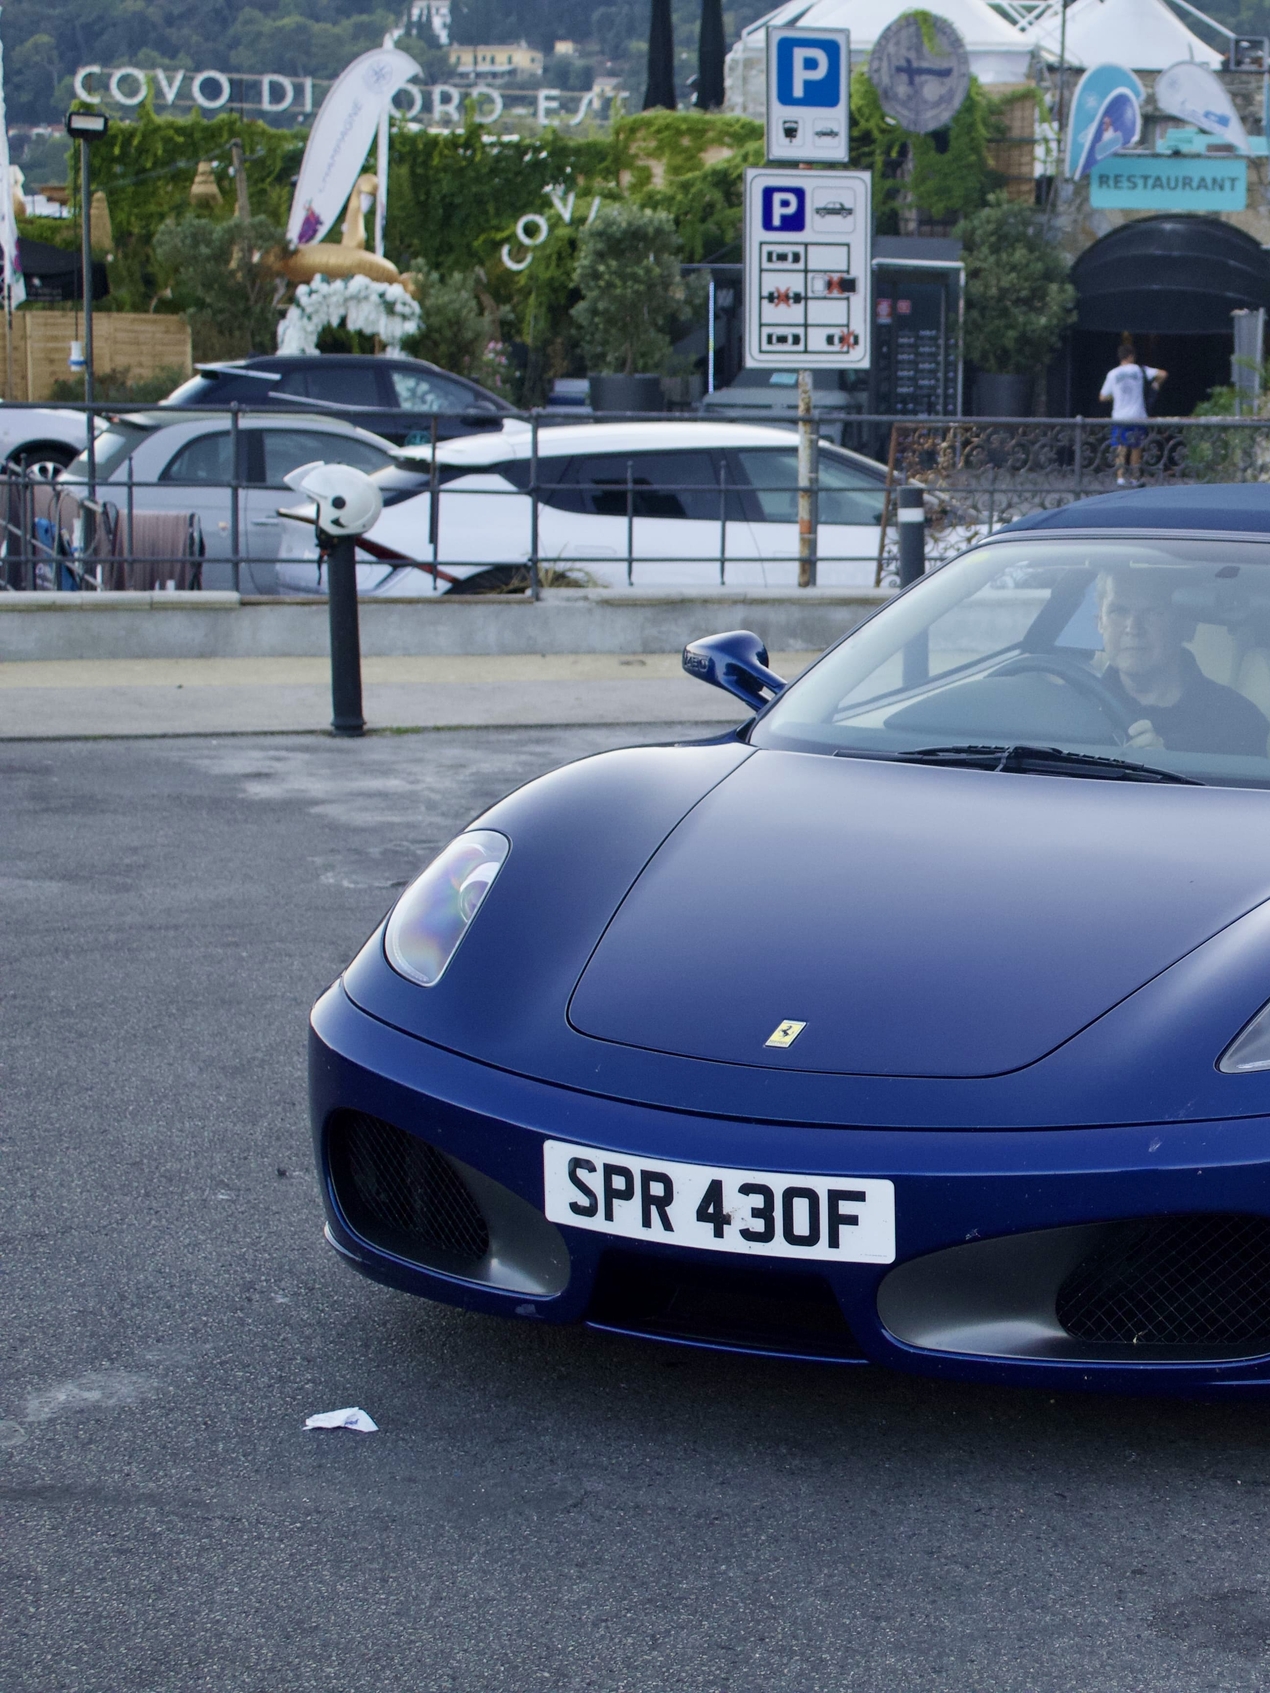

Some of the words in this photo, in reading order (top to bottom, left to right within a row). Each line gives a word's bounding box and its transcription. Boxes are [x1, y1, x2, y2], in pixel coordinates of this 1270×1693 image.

[73, 65, 231, 109] COVO
[261, 73, 313, 114] DI
[388, 83, 504, 125] ORD
[792, 46, 829, 98] P
[1097, 173, 1241, 192] RESTAURANT
[771, 191, 799, 228] P
[567, 1156, 675, 1233] SPR
[695, 1178, 867, 1250] 430F
